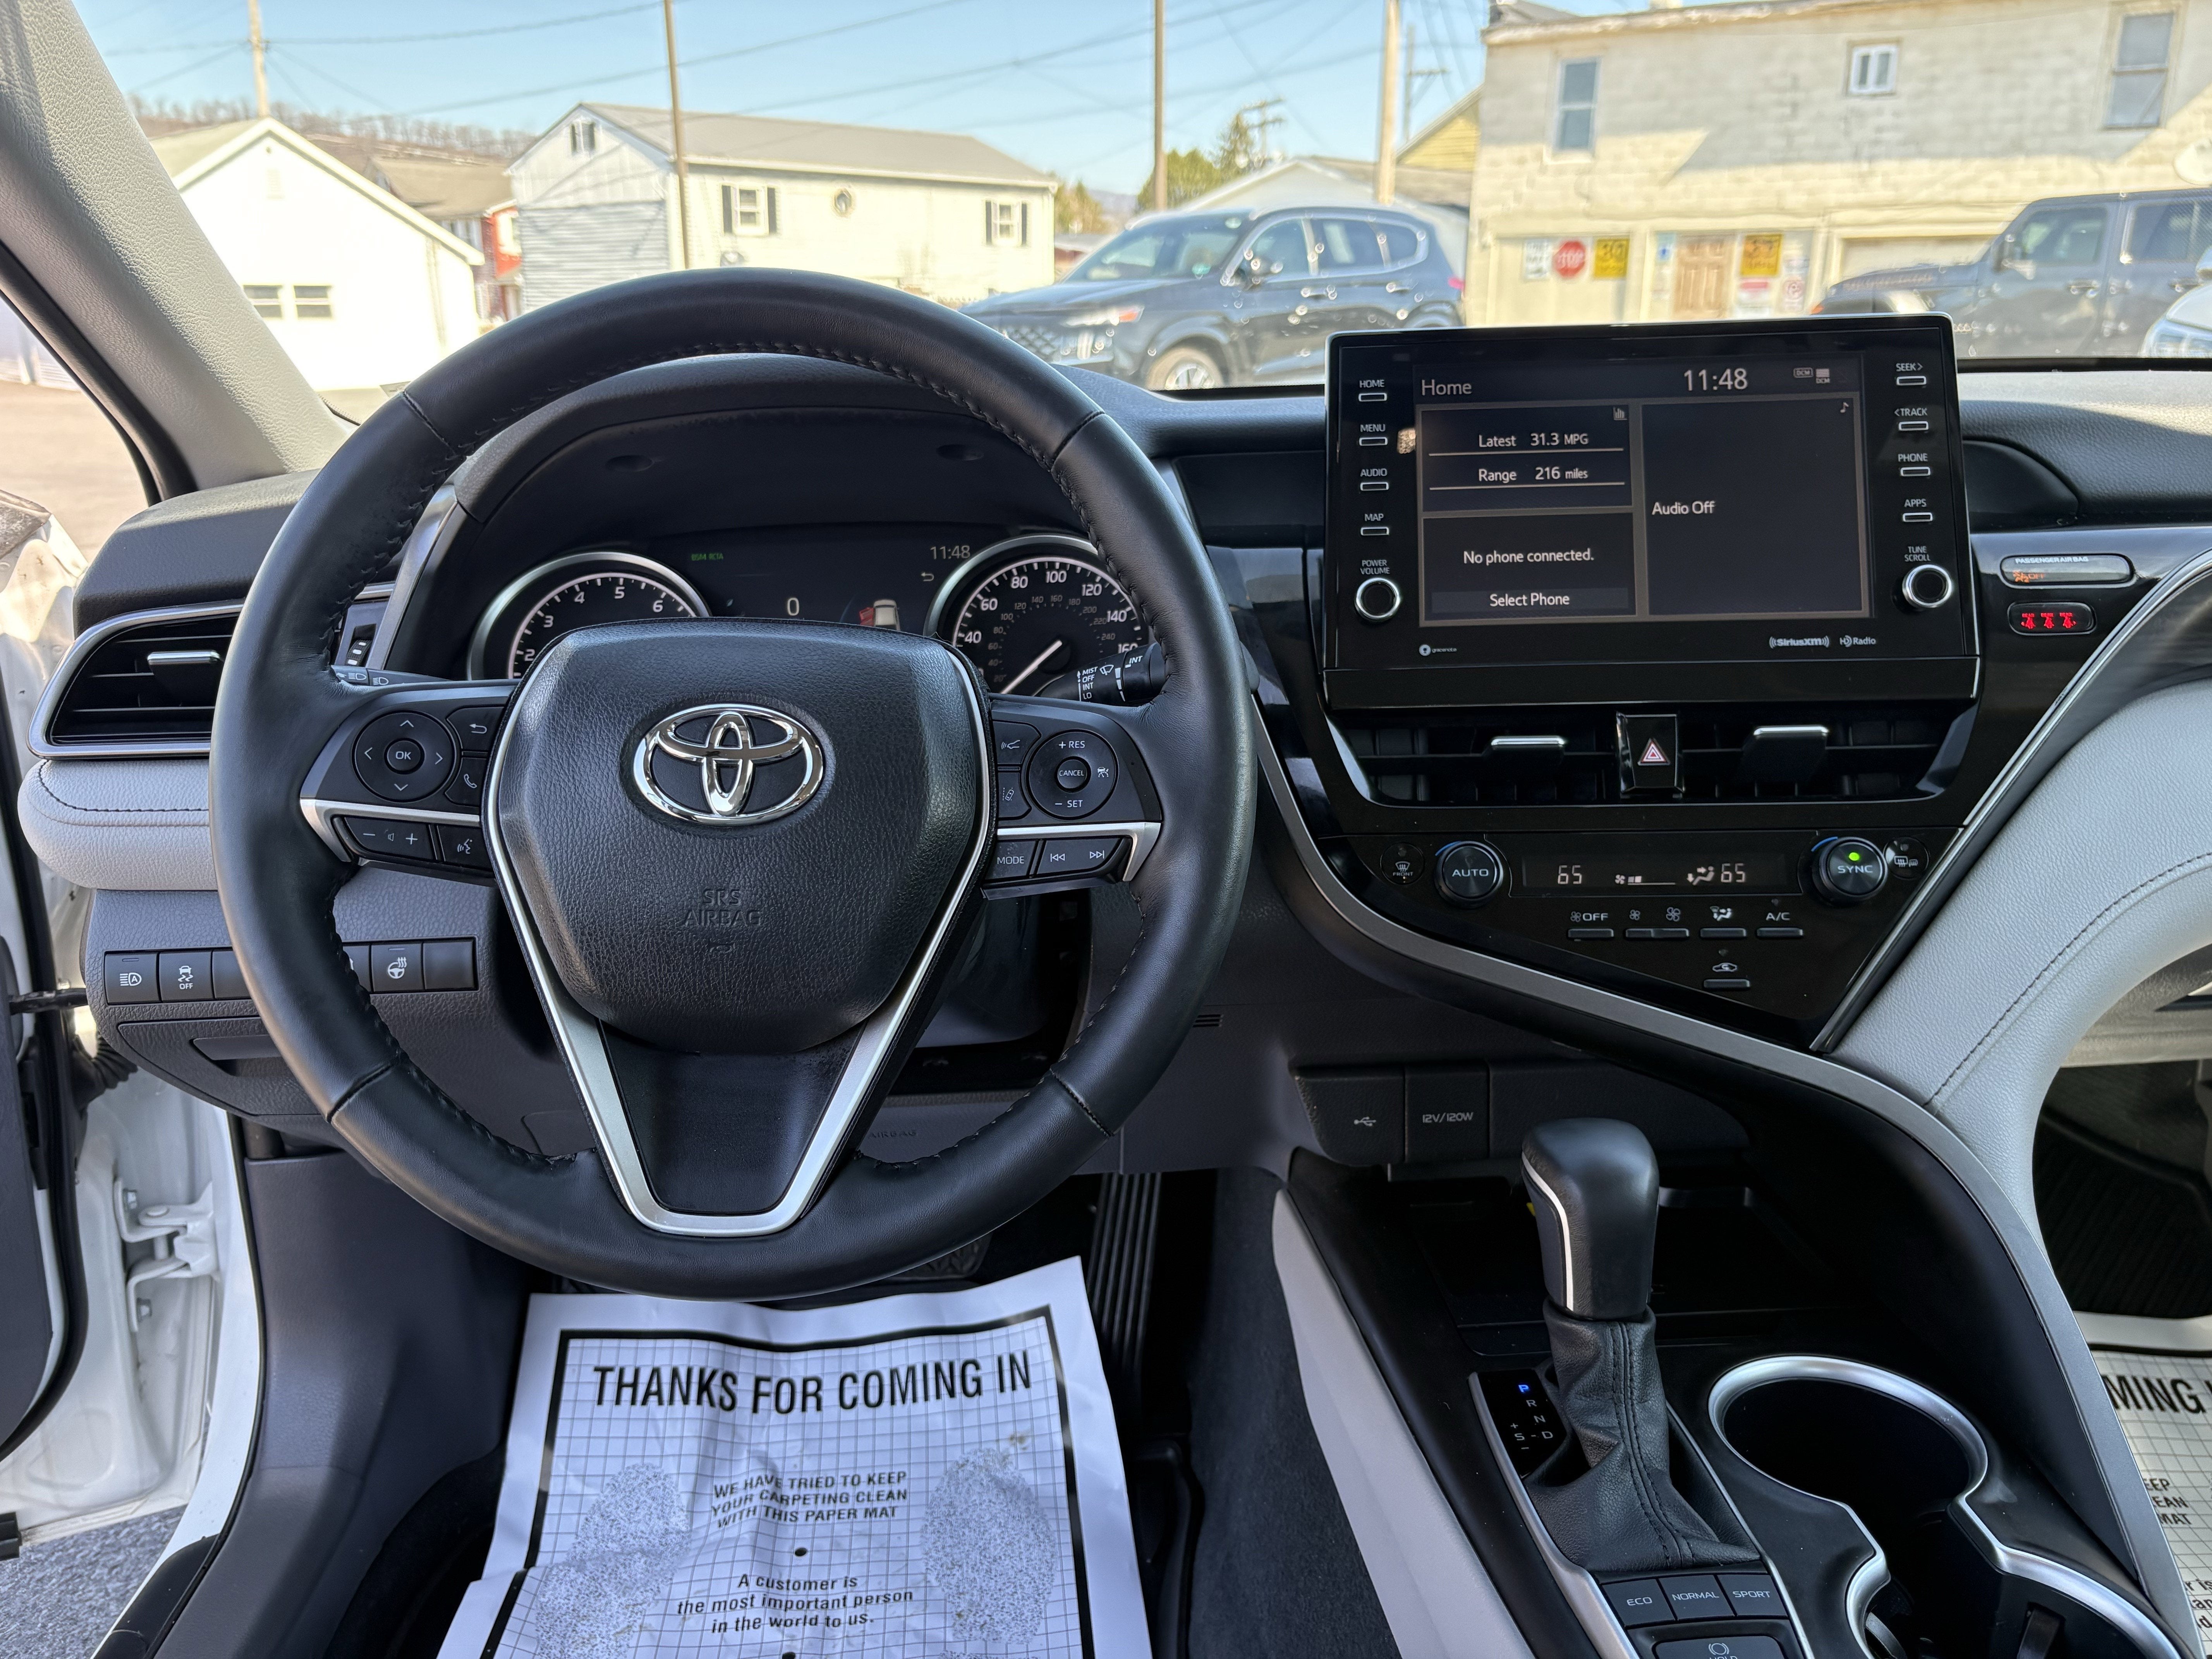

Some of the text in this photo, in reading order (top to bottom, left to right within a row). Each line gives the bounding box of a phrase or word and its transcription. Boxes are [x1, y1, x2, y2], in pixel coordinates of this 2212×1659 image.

[1360, 380, 1384, 388] HOME
[1684, 368, 1748, 391] 11:48
[1422, 380, 1472, 396] Home
[1479, 433, 1589, 447] Latest 31.3 MPG
[1898, 453, 1928, 462] PHONE
[1360, 468, 1387, 477] AUDIO
[1479, 467, 1588, 483] Range 216 miles
[1652, 501, 1716, 515] Audio Off
[1904, 499, 1927, 507] APPS
[1365, 513, 1384, 521] MAP
[931, 545, 970, 559] 11:48
[1464, 548, 1594, 565] No phone connected.
[1904, 554, 1930, 562] SCROLL
[1046, 571, 1066, 582] 100
[1011, 577, 1028, 588] 80
[615, 587, 624, 598] 5
[1082, 584, 1102, 596] 120
[575, 592, 585, 603] 4
[1490, 593, 1570, 607] Select Phone
[653, 601, 663, 612] 6
[981, 599, 998, 610] 60
[544, 616, 553, 627] 3
[1106, 610, 1127, 622] 140
[964, 632, 981, 643] 40
[524, 649, 535, 661] 2
[1129, 656, 1143, 664] INT
[1082, 666, 1098, 675] MIST
[396, 751, 411, 760] OK
[997, 856, 1024, 864] MODE
[1451, 868, 1489, 877] AUTO
[1720, 863, 1746, 883] 65
[1837, 864, 1873, 874] SYNC
[1557, 866, 1582, 884] 65
[703, 891, 740, 906] SRS
[685, 910, 763, 926] AIRBAG
[1582, 912, 1608, 921] OFF
[1765, 912, 1790, 921] A/C
[1422, 1112, 1474, 1123] 12V/120W
[594, 1350, 1032, 1414] THANKS FOR COMING IN
[714, 1472, 907, 1498] WE HAVE TRIED TO KEEP
[711, 1489, 907, 1516] YOUR CARPETING CLEAN
[718, 1506, 897, 1528] WITH THIS PAPER MAT
[738, 1574, 858, 1590] A customer is
[1627, 1597, 1652, 1606] ECO
[1671, 1591, 1719, 1601] NORMAL
[677, 1591, 913, 1614] the most important person
[712, 1619, 728, 1633] in
[734, 1616, 762, 1632] the
[769, 1614, 817, 1627] world
[825, 1616, 841, 1627] to
